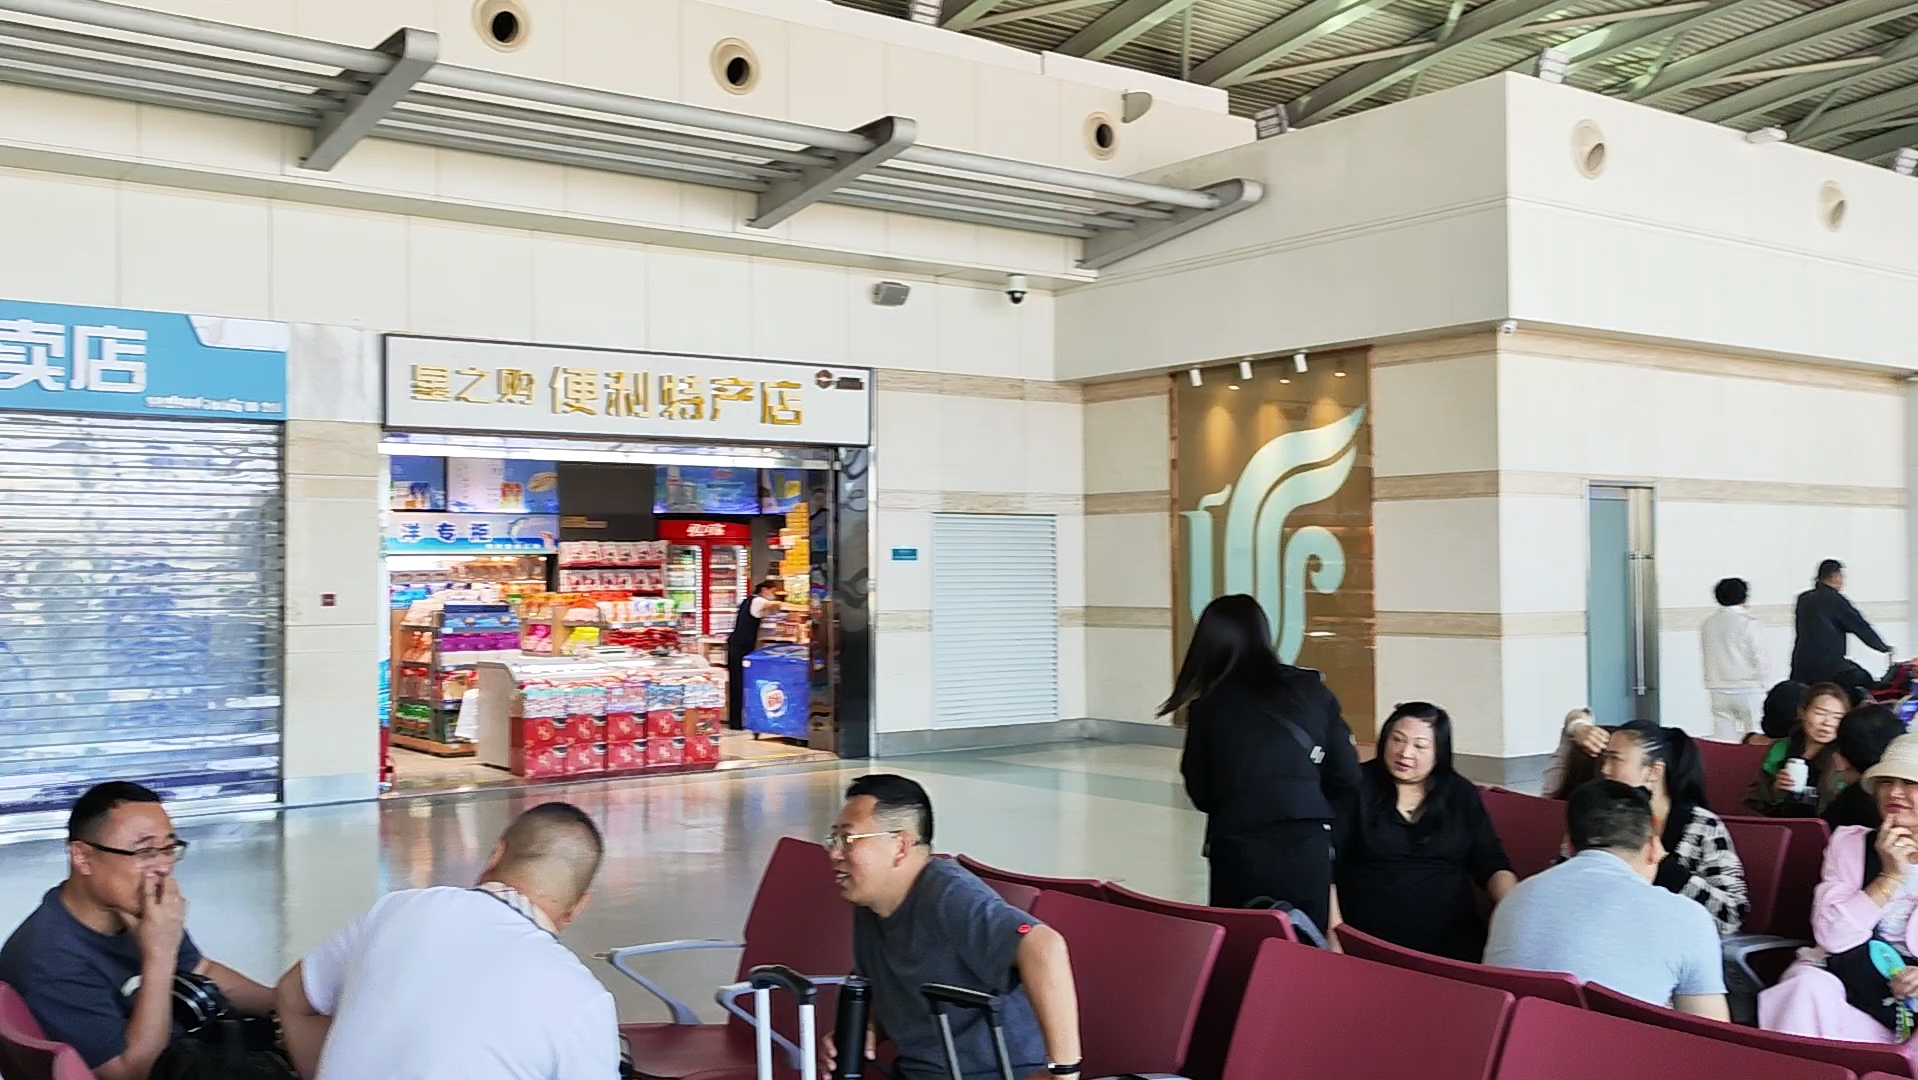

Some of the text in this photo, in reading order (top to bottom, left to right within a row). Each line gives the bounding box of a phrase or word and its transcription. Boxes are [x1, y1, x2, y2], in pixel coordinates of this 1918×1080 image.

[0, 318, 147, 393] 卖店
[549, 365, 802, 424] 便利特产店
